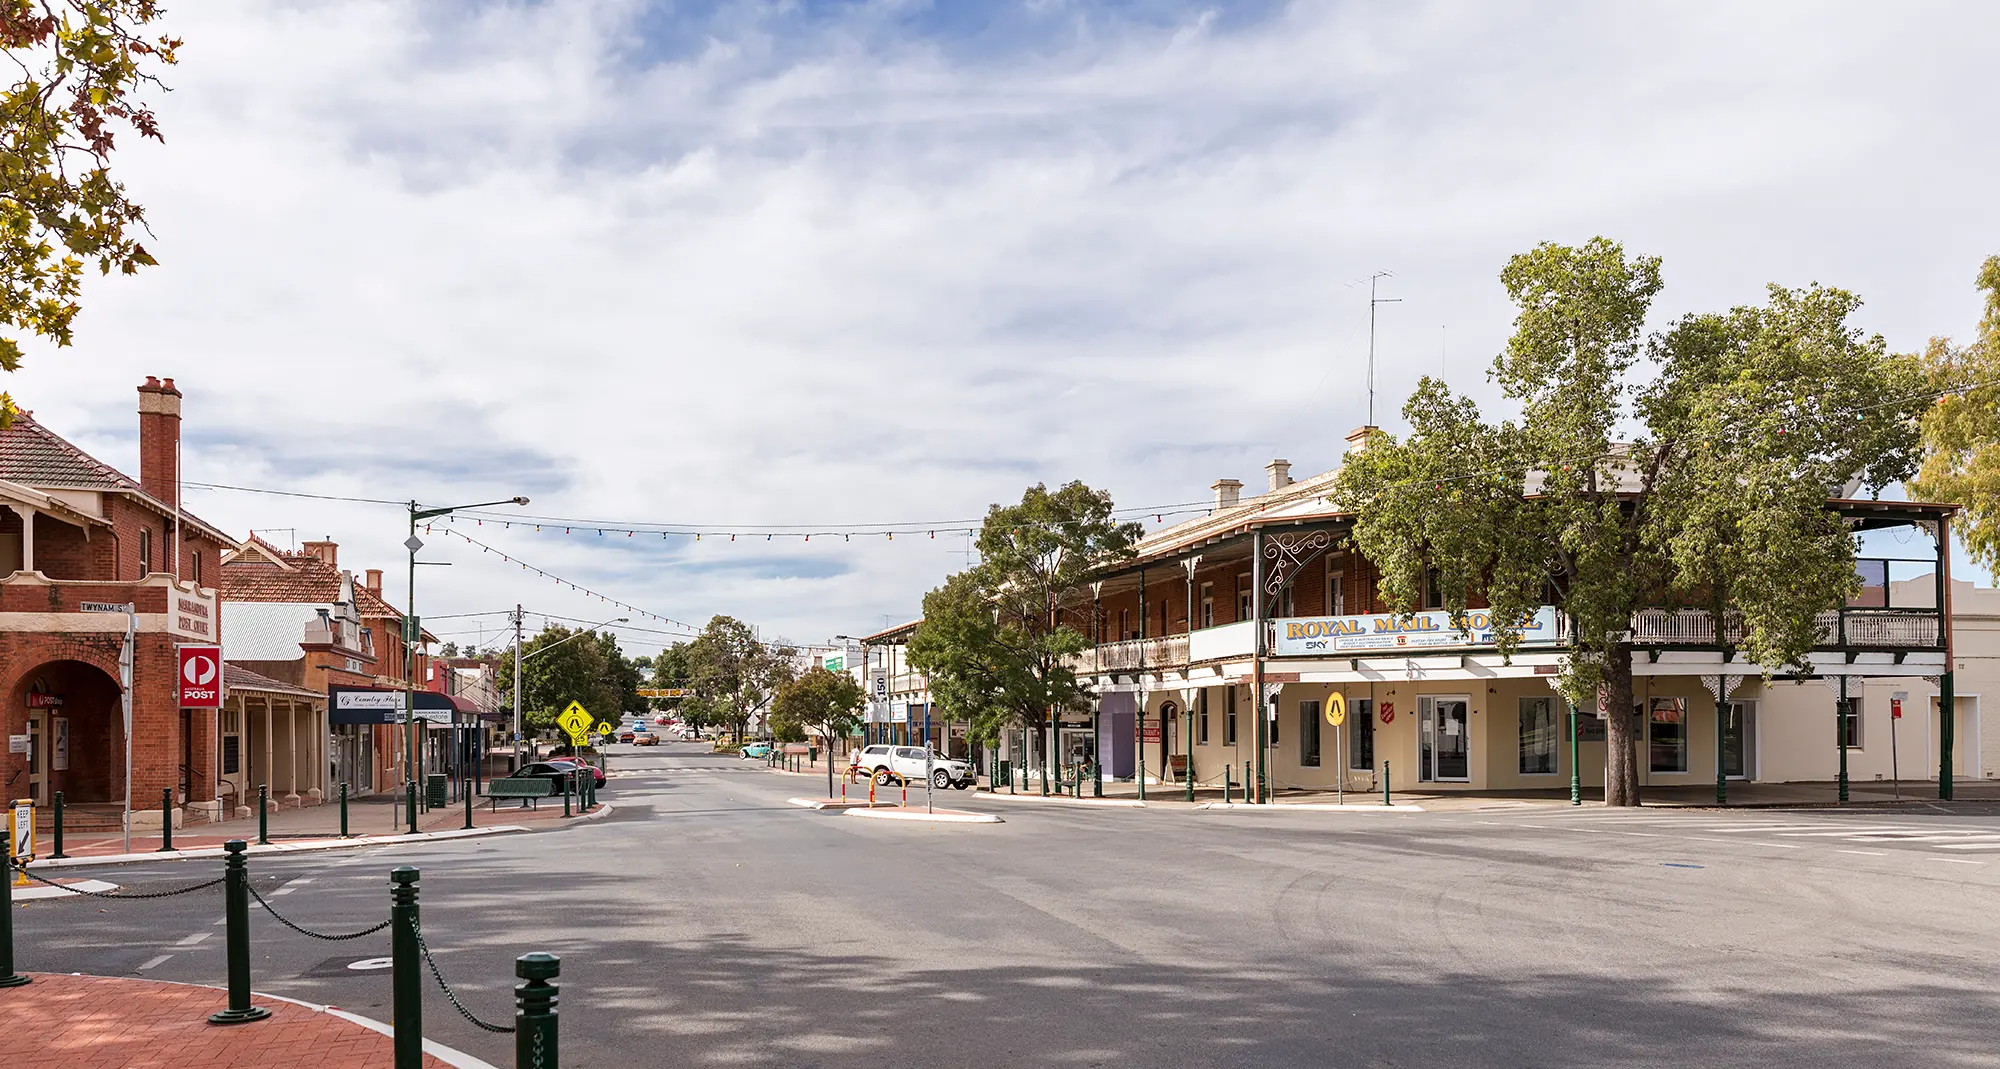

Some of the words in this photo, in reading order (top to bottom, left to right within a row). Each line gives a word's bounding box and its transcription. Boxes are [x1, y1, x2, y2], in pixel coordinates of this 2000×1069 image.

[82, 602, 115, 612] TWYNAM
[1286, 619, 1367, 641] ROYAL
[1373, 615, 1441, 634] MAIL
[1306, 640, 1329, 650] SKY
[876, 677, 886, 697] 150
[184, 691, 216, 700] POST
[354, 695, 381, 705] Country
[17, 809, 29, 819] KEEP
[18, 820, 28, 830] LEFT
